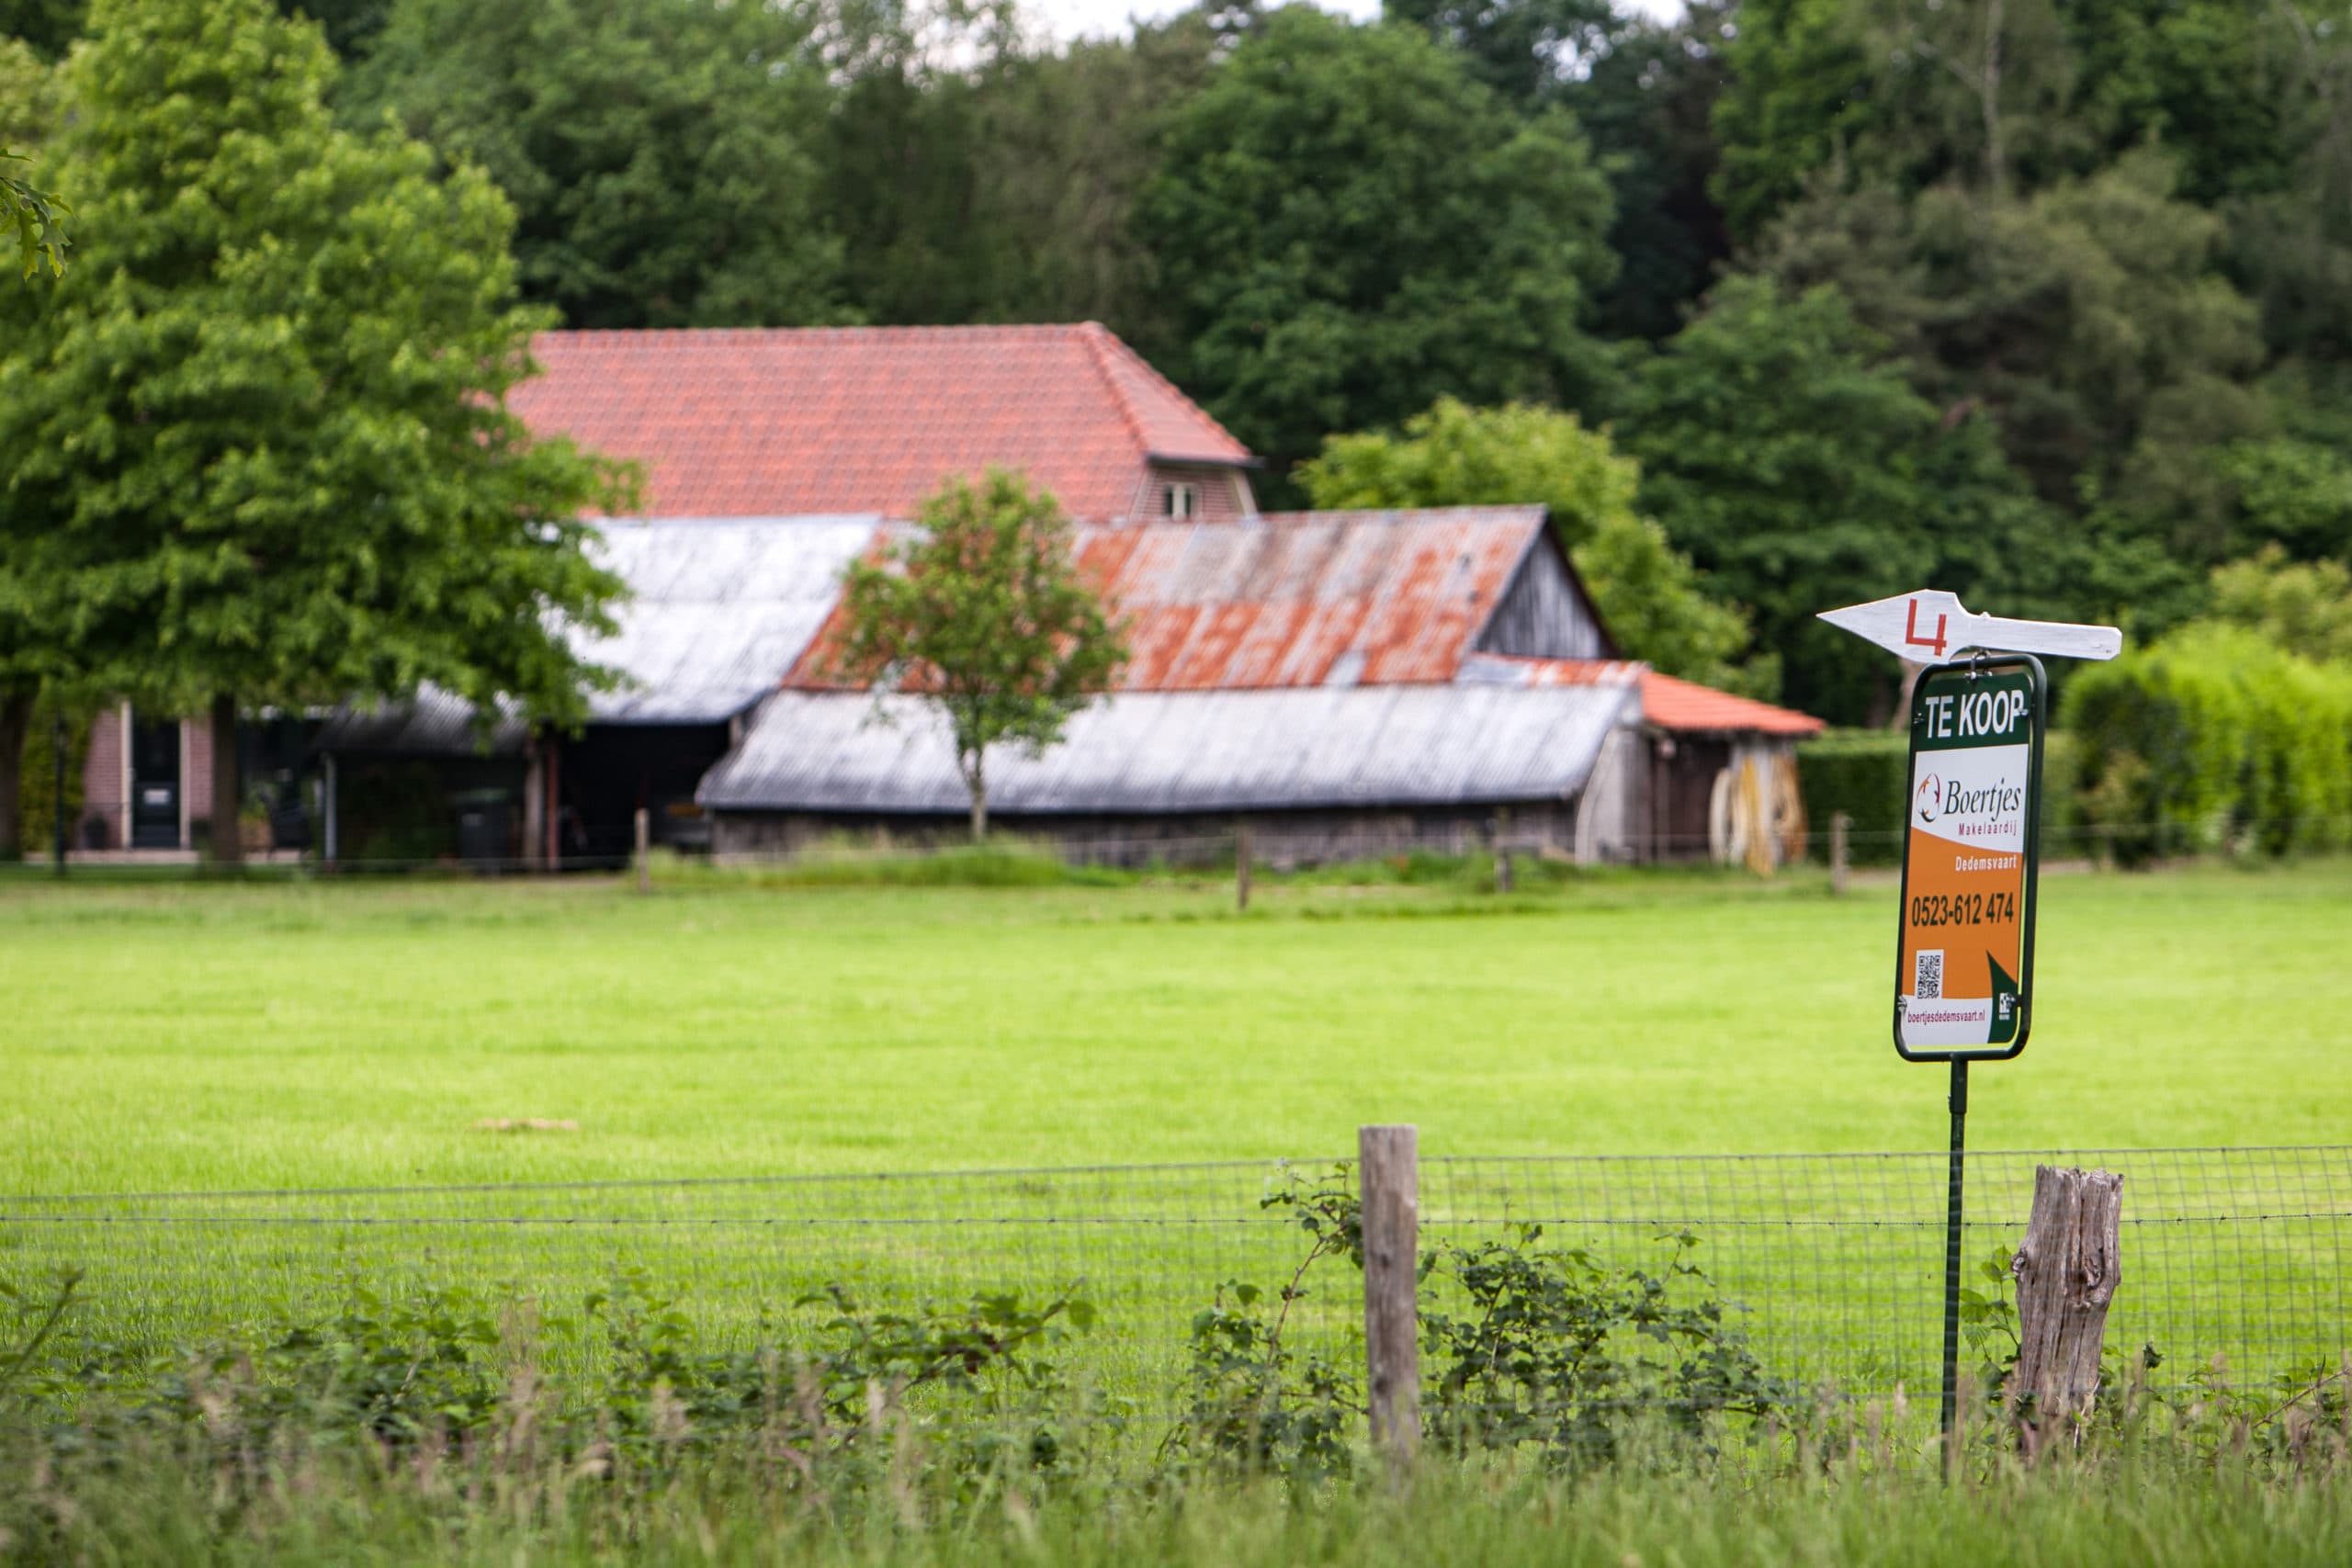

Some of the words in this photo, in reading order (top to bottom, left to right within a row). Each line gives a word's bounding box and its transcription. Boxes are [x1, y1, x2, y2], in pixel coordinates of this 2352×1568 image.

[1905, 599, 1947, 656] 4
[1926, 694, 1953, 739] TE
[1959, 690, 2024, 736] KOOP
[1943, 777, 2021, 821] Boertjes
[1958, 820, 2018, 836] Makelaardij
[1955, 855, 2018, 871] Dedemsvaart
[1912, 893, 1982, 926] 0523-612
[1986, 892, 2014, 923] 474
[1907, 1010, 1985, 1025] boertjesdedemsvaart.nl
